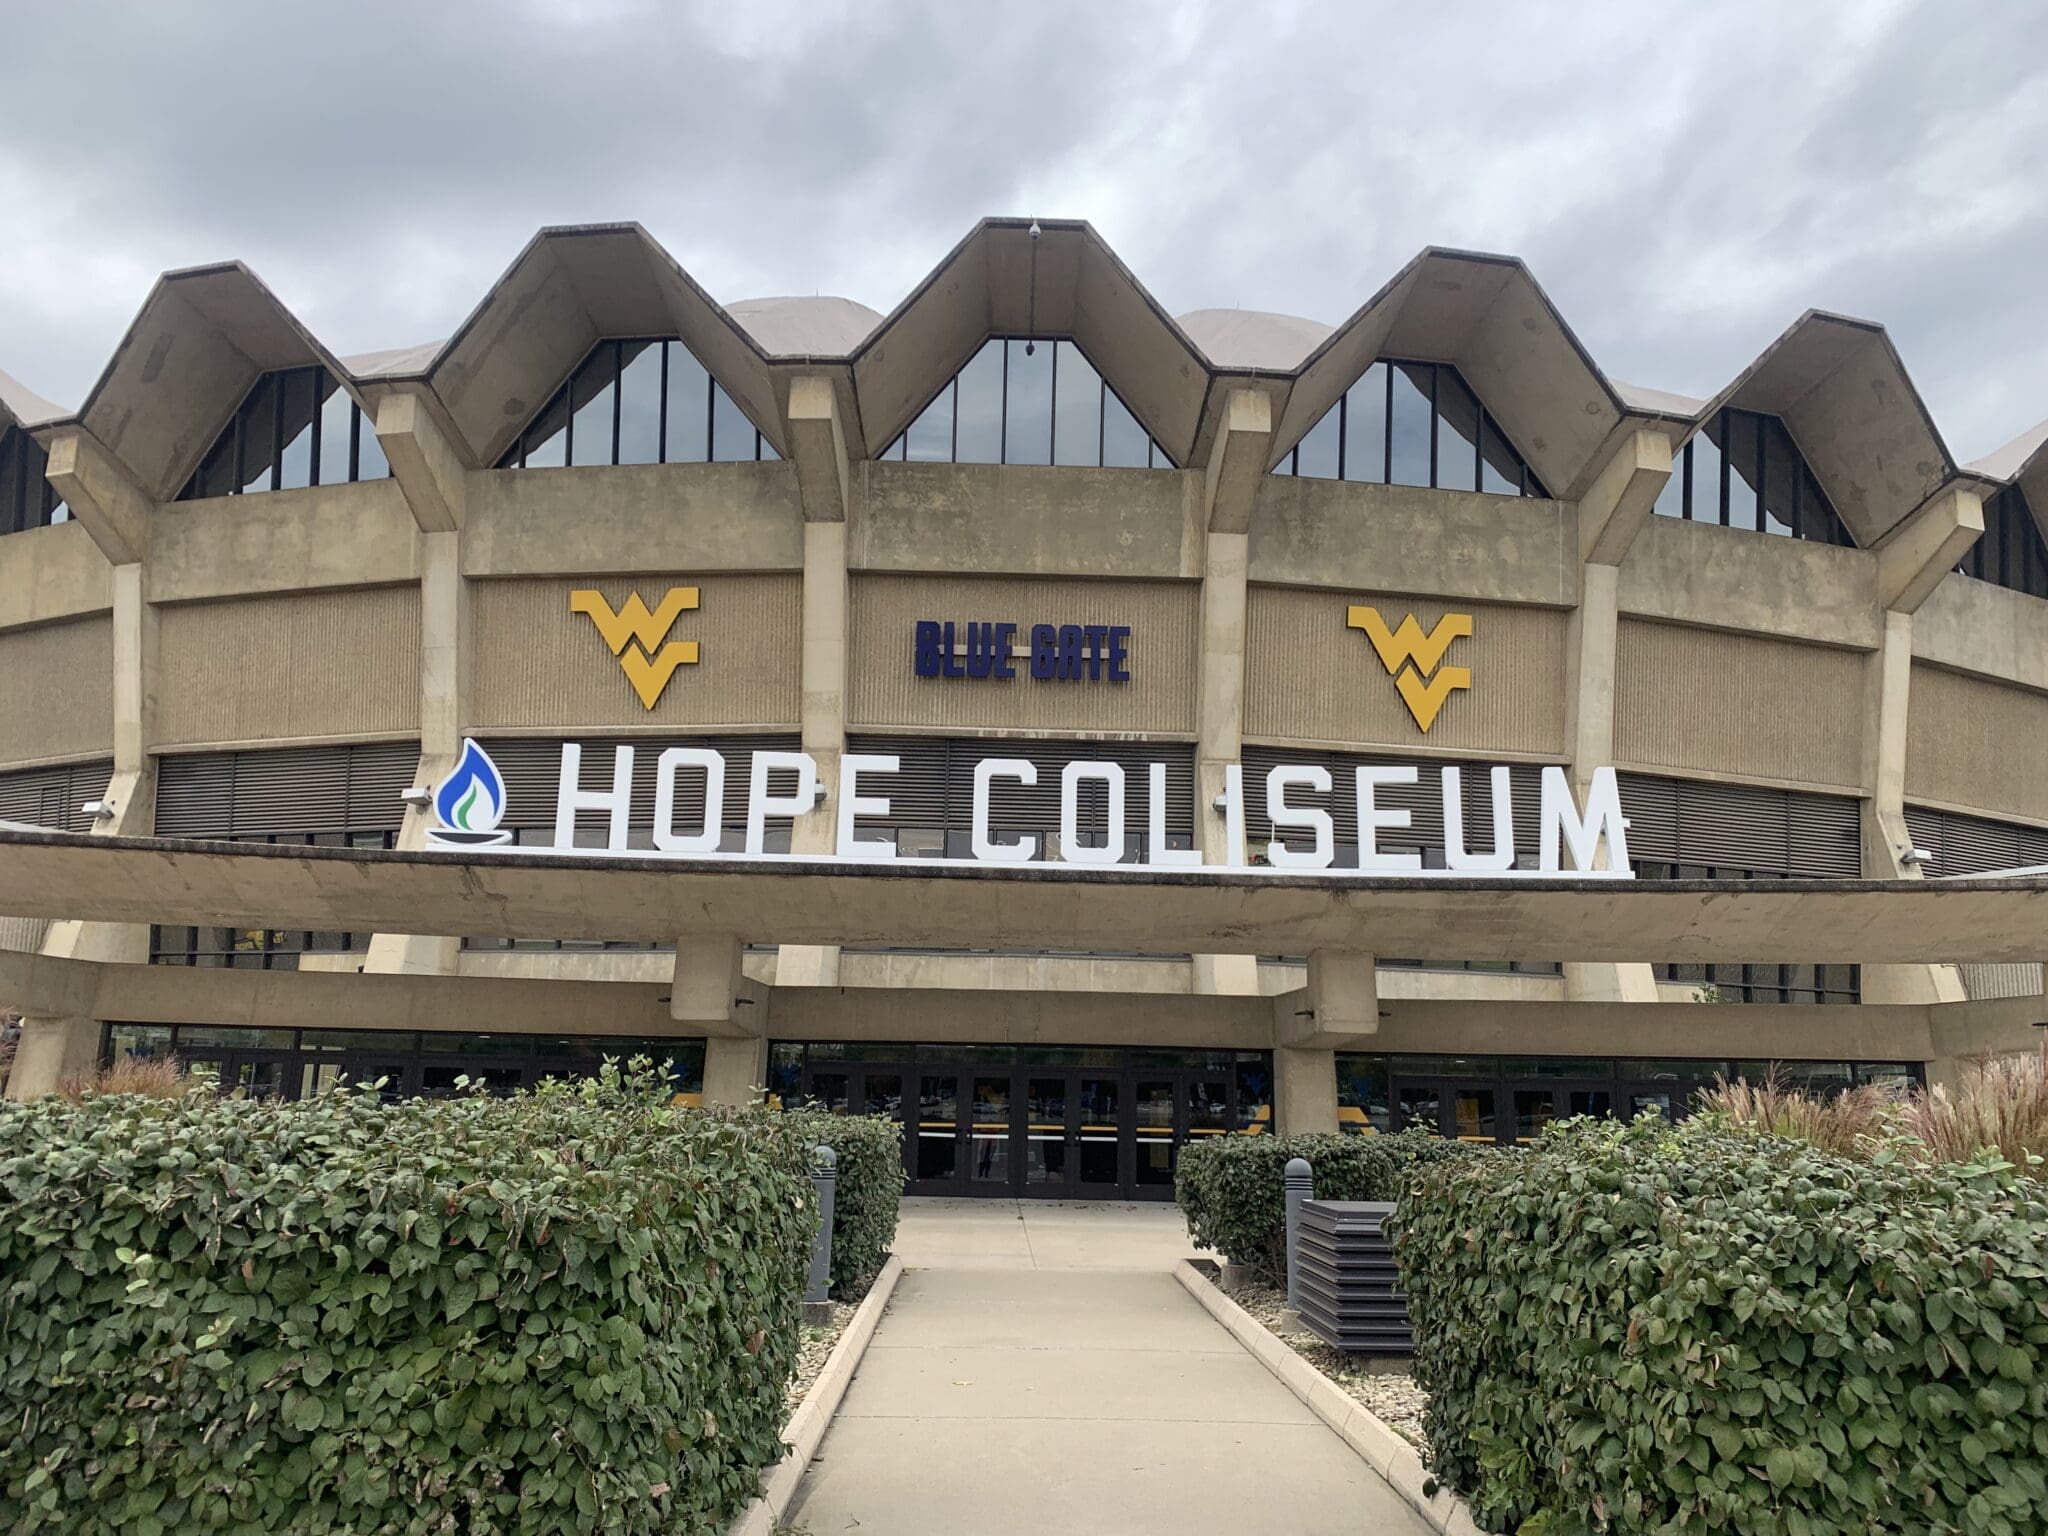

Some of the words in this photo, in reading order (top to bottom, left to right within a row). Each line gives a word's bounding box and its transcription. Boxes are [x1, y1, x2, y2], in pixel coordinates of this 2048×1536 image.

[915, 621, 1017, 678] BLUE
[1031, 624, 1131, 682] GATE
[554, 743, 900, 858] HOPE
[970, 759, 1633, 877] COLISEUM
